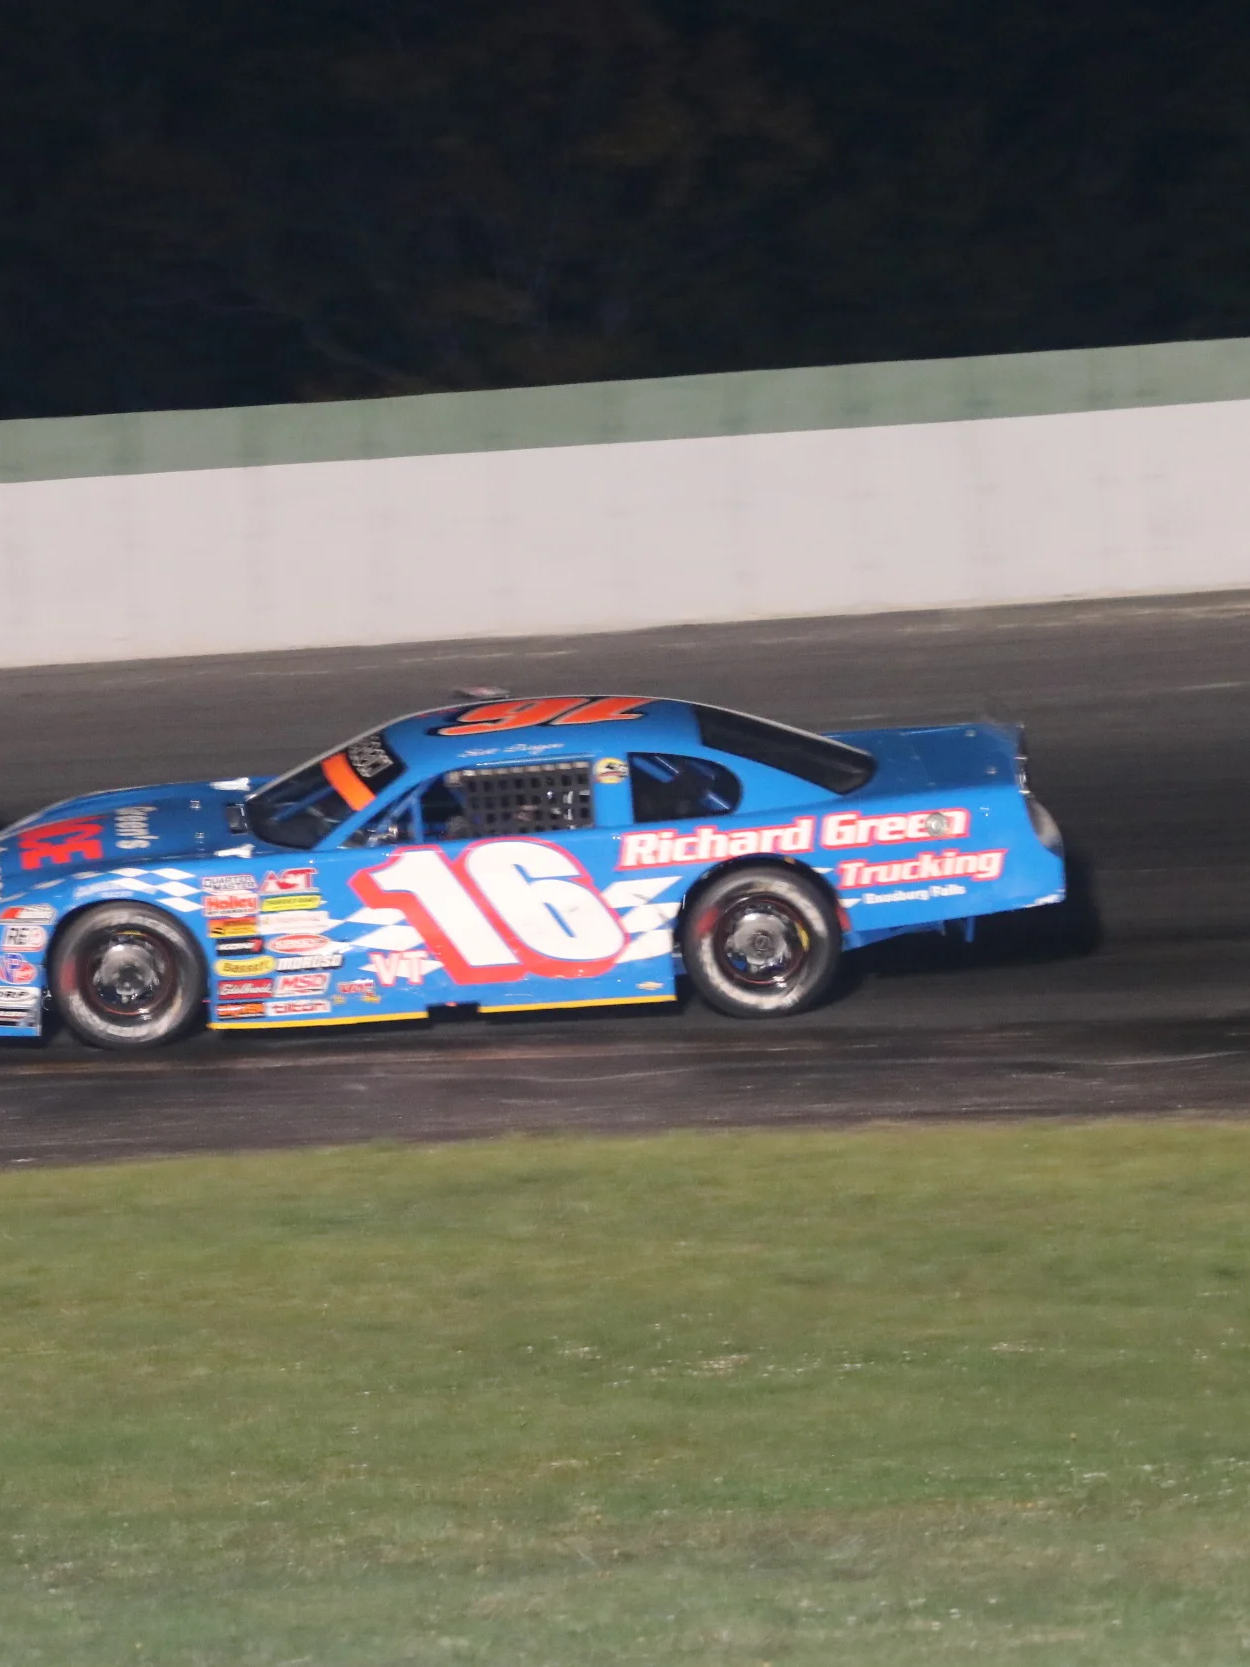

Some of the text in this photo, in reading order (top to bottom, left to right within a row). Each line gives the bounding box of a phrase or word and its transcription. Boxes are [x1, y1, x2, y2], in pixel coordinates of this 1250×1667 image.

[617, 808, 970, 872] Richard Green
[204, 876, 252, 887] QUARTER
[213, 882, 255, 890] MASTER
[838, 849, 1007, 890] Trucking
[207, 895, 257, 911] Holley
[347, 837, 630, 985] 16
[368, 951, 429, 987] VT
